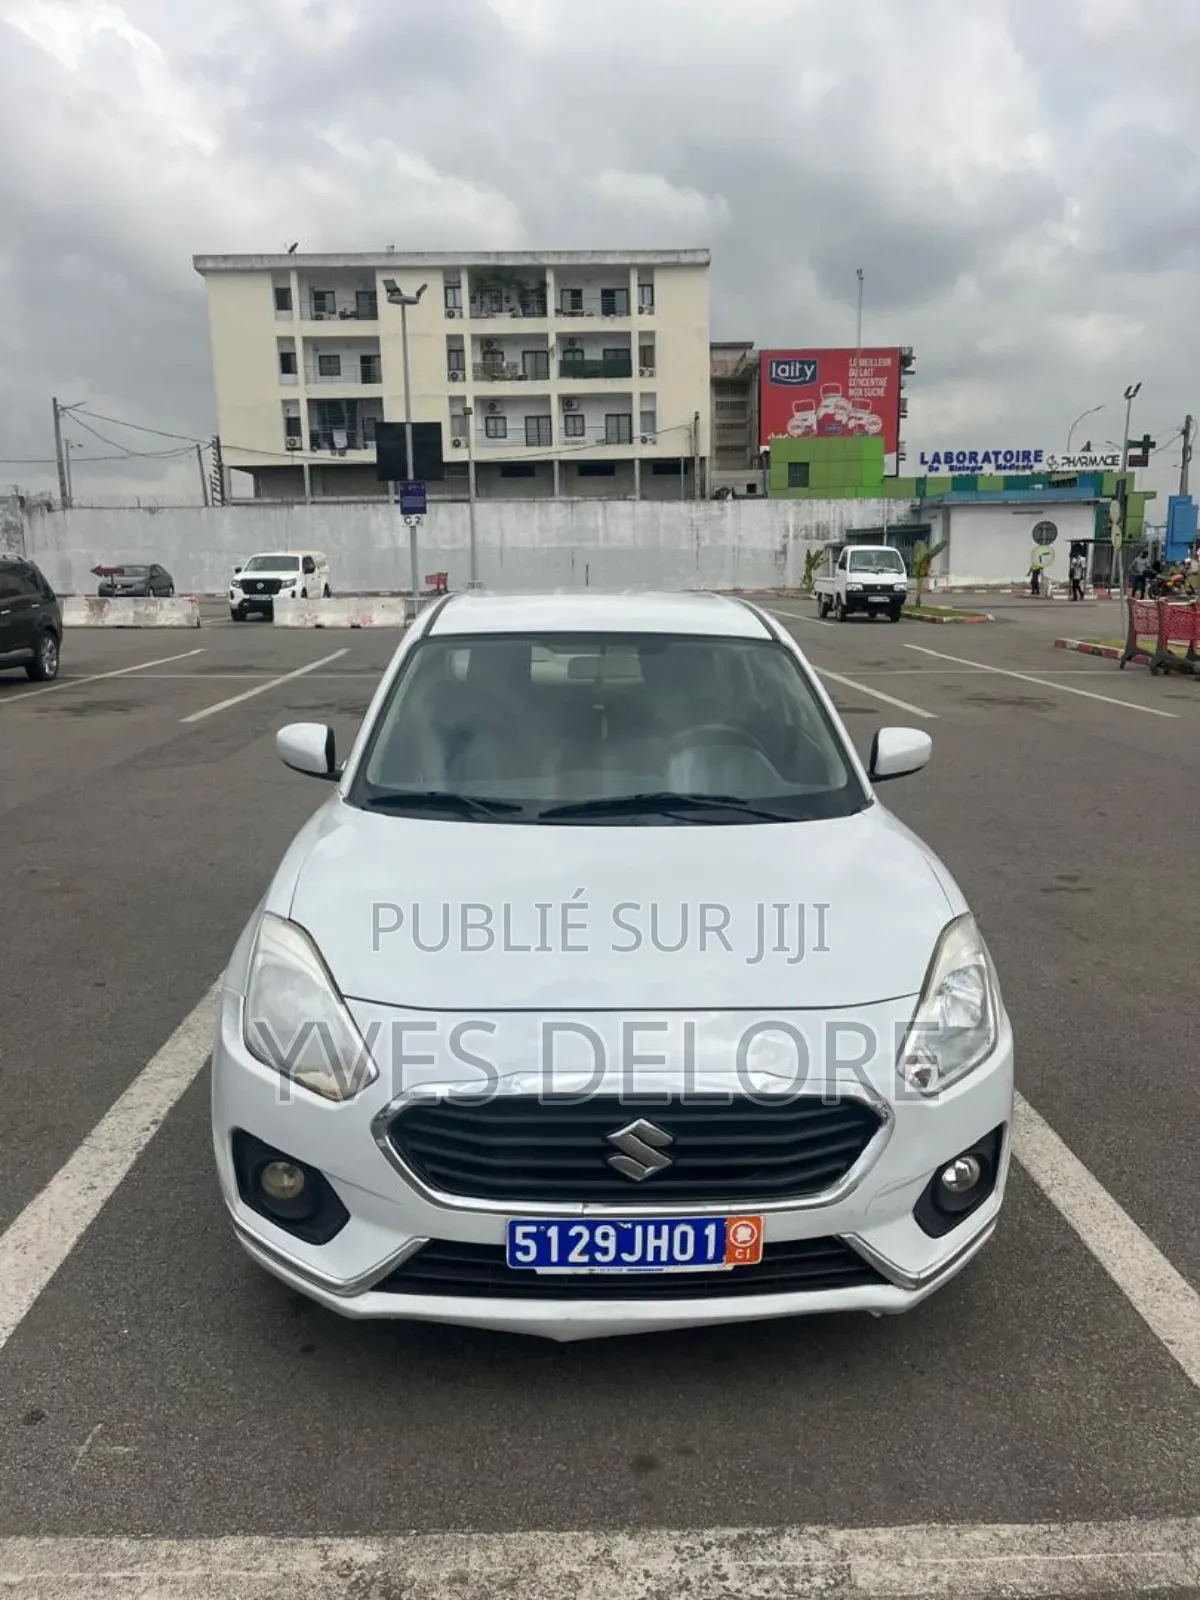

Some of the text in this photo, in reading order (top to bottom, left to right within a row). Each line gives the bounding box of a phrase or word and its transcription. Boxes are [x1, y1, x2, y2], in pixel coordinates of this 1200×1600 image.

[772, 361, 815, 379] laity
[859, 368, 875, 377] LAIT
[920, 450, 1044, 465] LABORATOIRE
[515, 1223, 718, 1262] 5129JH01
[735, 1248, 751, 1260] CI
